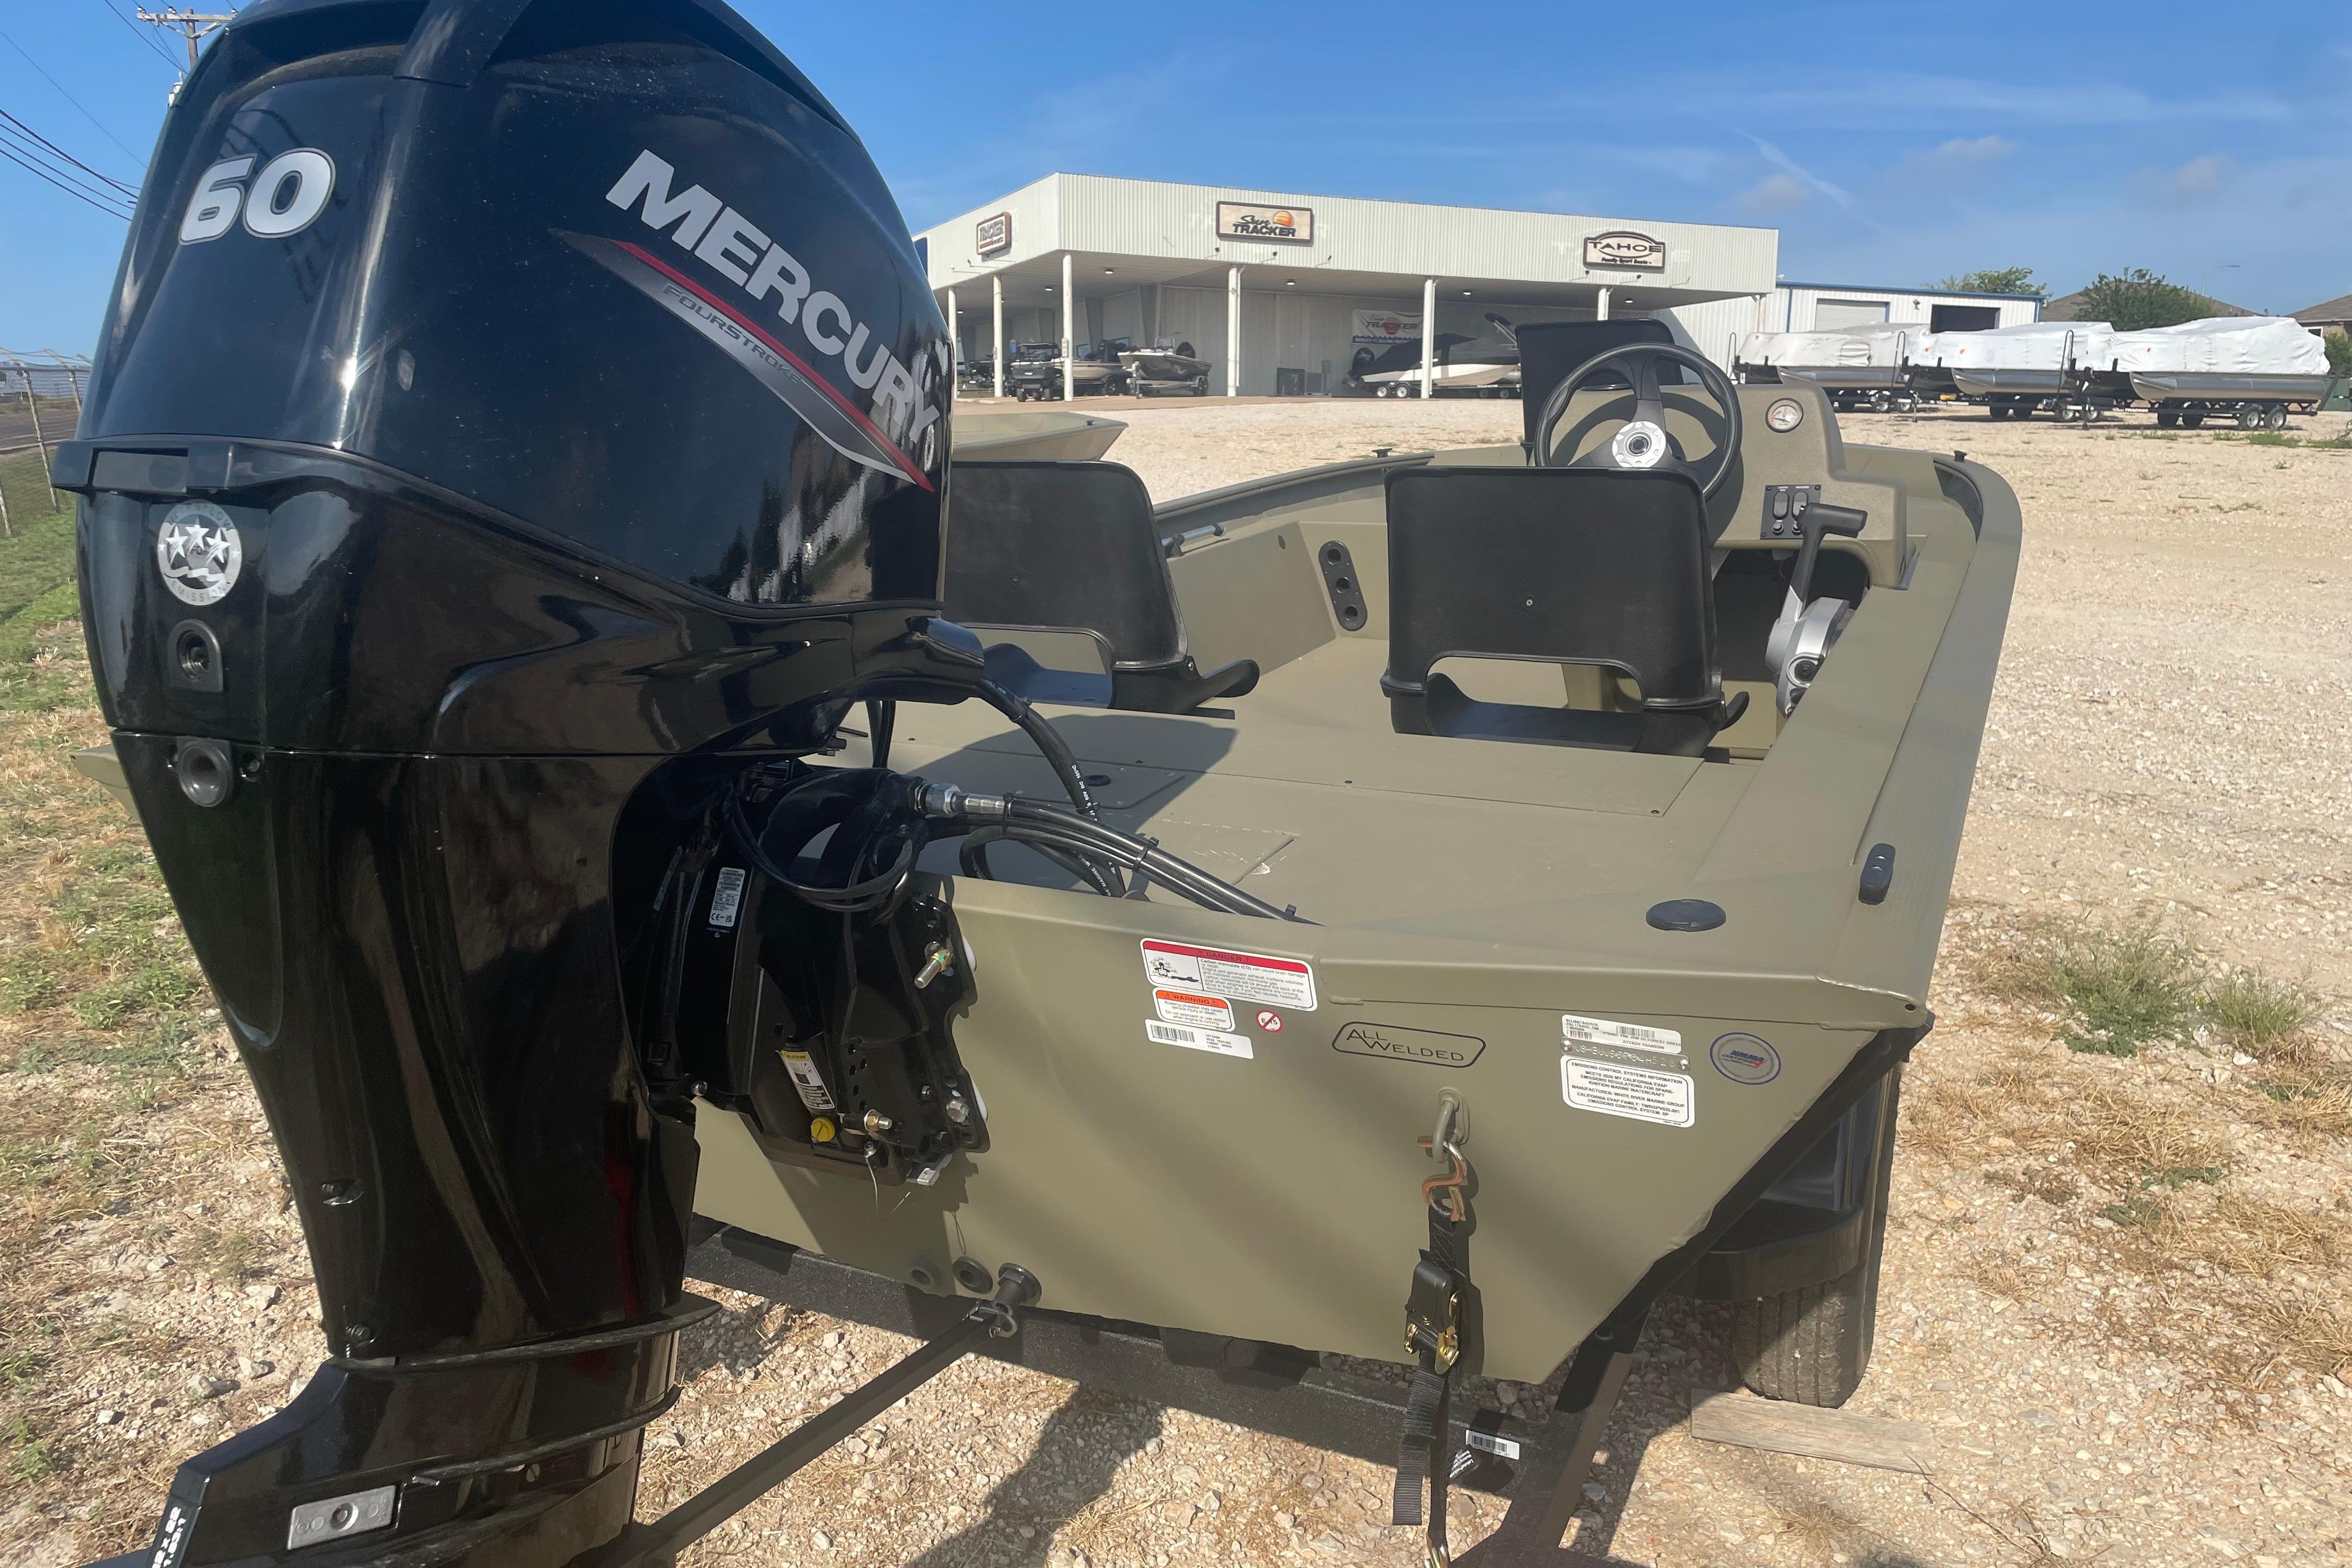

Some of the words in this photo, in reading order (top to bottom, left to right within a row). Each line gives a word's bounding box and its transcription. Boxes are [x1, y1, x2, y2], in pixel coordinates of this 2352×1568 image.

[177, 146, 338, 247] 60
[1232, 223, 1296, 237] TRACKER
[1588, 241, 1662, 253] TAHOE
[604, 148, 940, 444] MERCURY
[662, 282, 801, 385] FOURSTROKE
[1079, 780, 1086, 789] DC
[1091, 867, 1107, 887] MARINE
[1206, 951, 1242, 962] DANGER
[1172, 994, 1210, 1005] WARNING
[1346, 1028, 1388, 1041] ALL
[1360, 1037, 1465, 1061] WELDED
[1572, 1062, 1597, 1070] EMISSIONS
[1648, 1074, 1682, 1084] INFORMATION
[1608, 1079, 1642, 1088] REGULATIONS
[1623, 1077, 1652, 1085] CALIFORNIA
[1577, 1092, 1605, 1100] CALIFORNIA
[1630, 1088, 1664, 1097] WATERCRAFT
